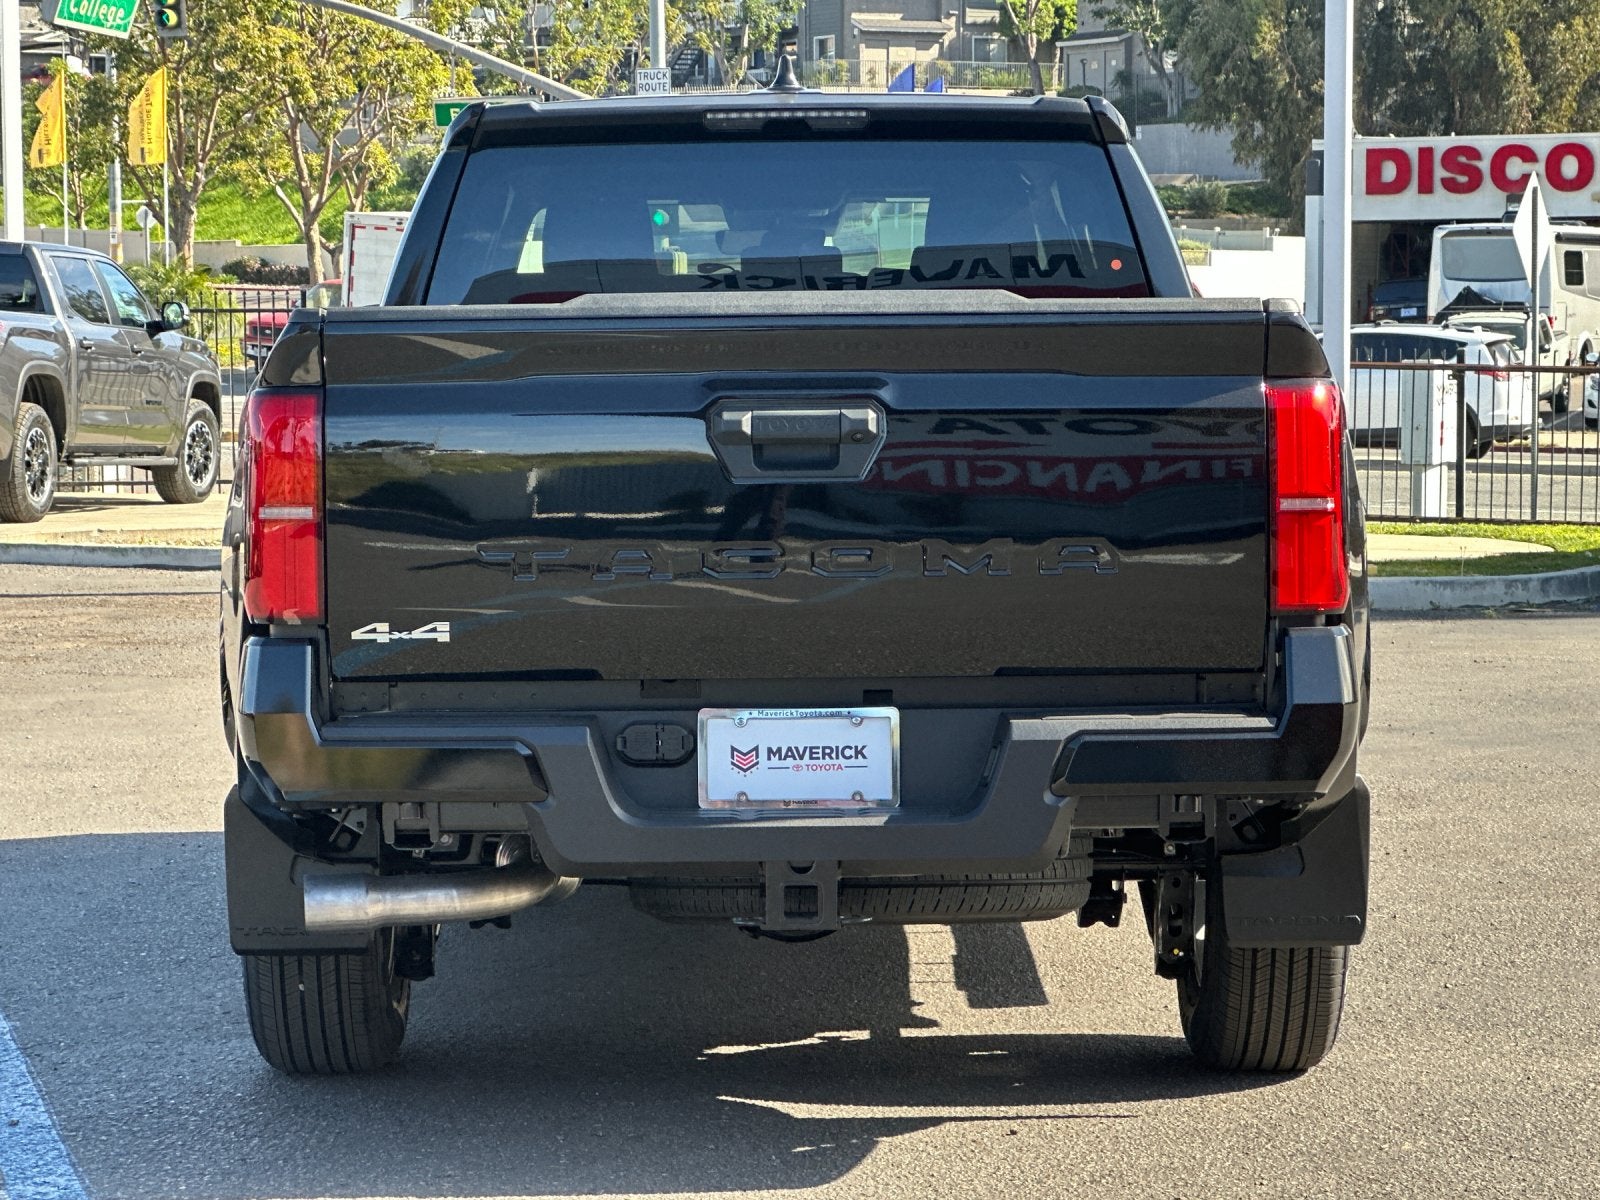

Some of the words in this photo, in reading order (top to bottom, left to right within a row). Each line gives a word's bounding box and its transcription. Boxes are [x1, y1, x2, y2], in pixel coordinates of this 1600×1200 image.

[69, 0, 125, 28] College
[638, 71, 668, 80] TRUCK
[638, 82, 668, 91] ROUTE
[477, 540, 1119, 580] TACOMA
[351, 622, 450, 642] 4x4
[757, 709, 843, 718] MaverickToyota.com
[767, 744, 868, 761] MAVERICK
[805, 763, 843, 772] TOYOTA
